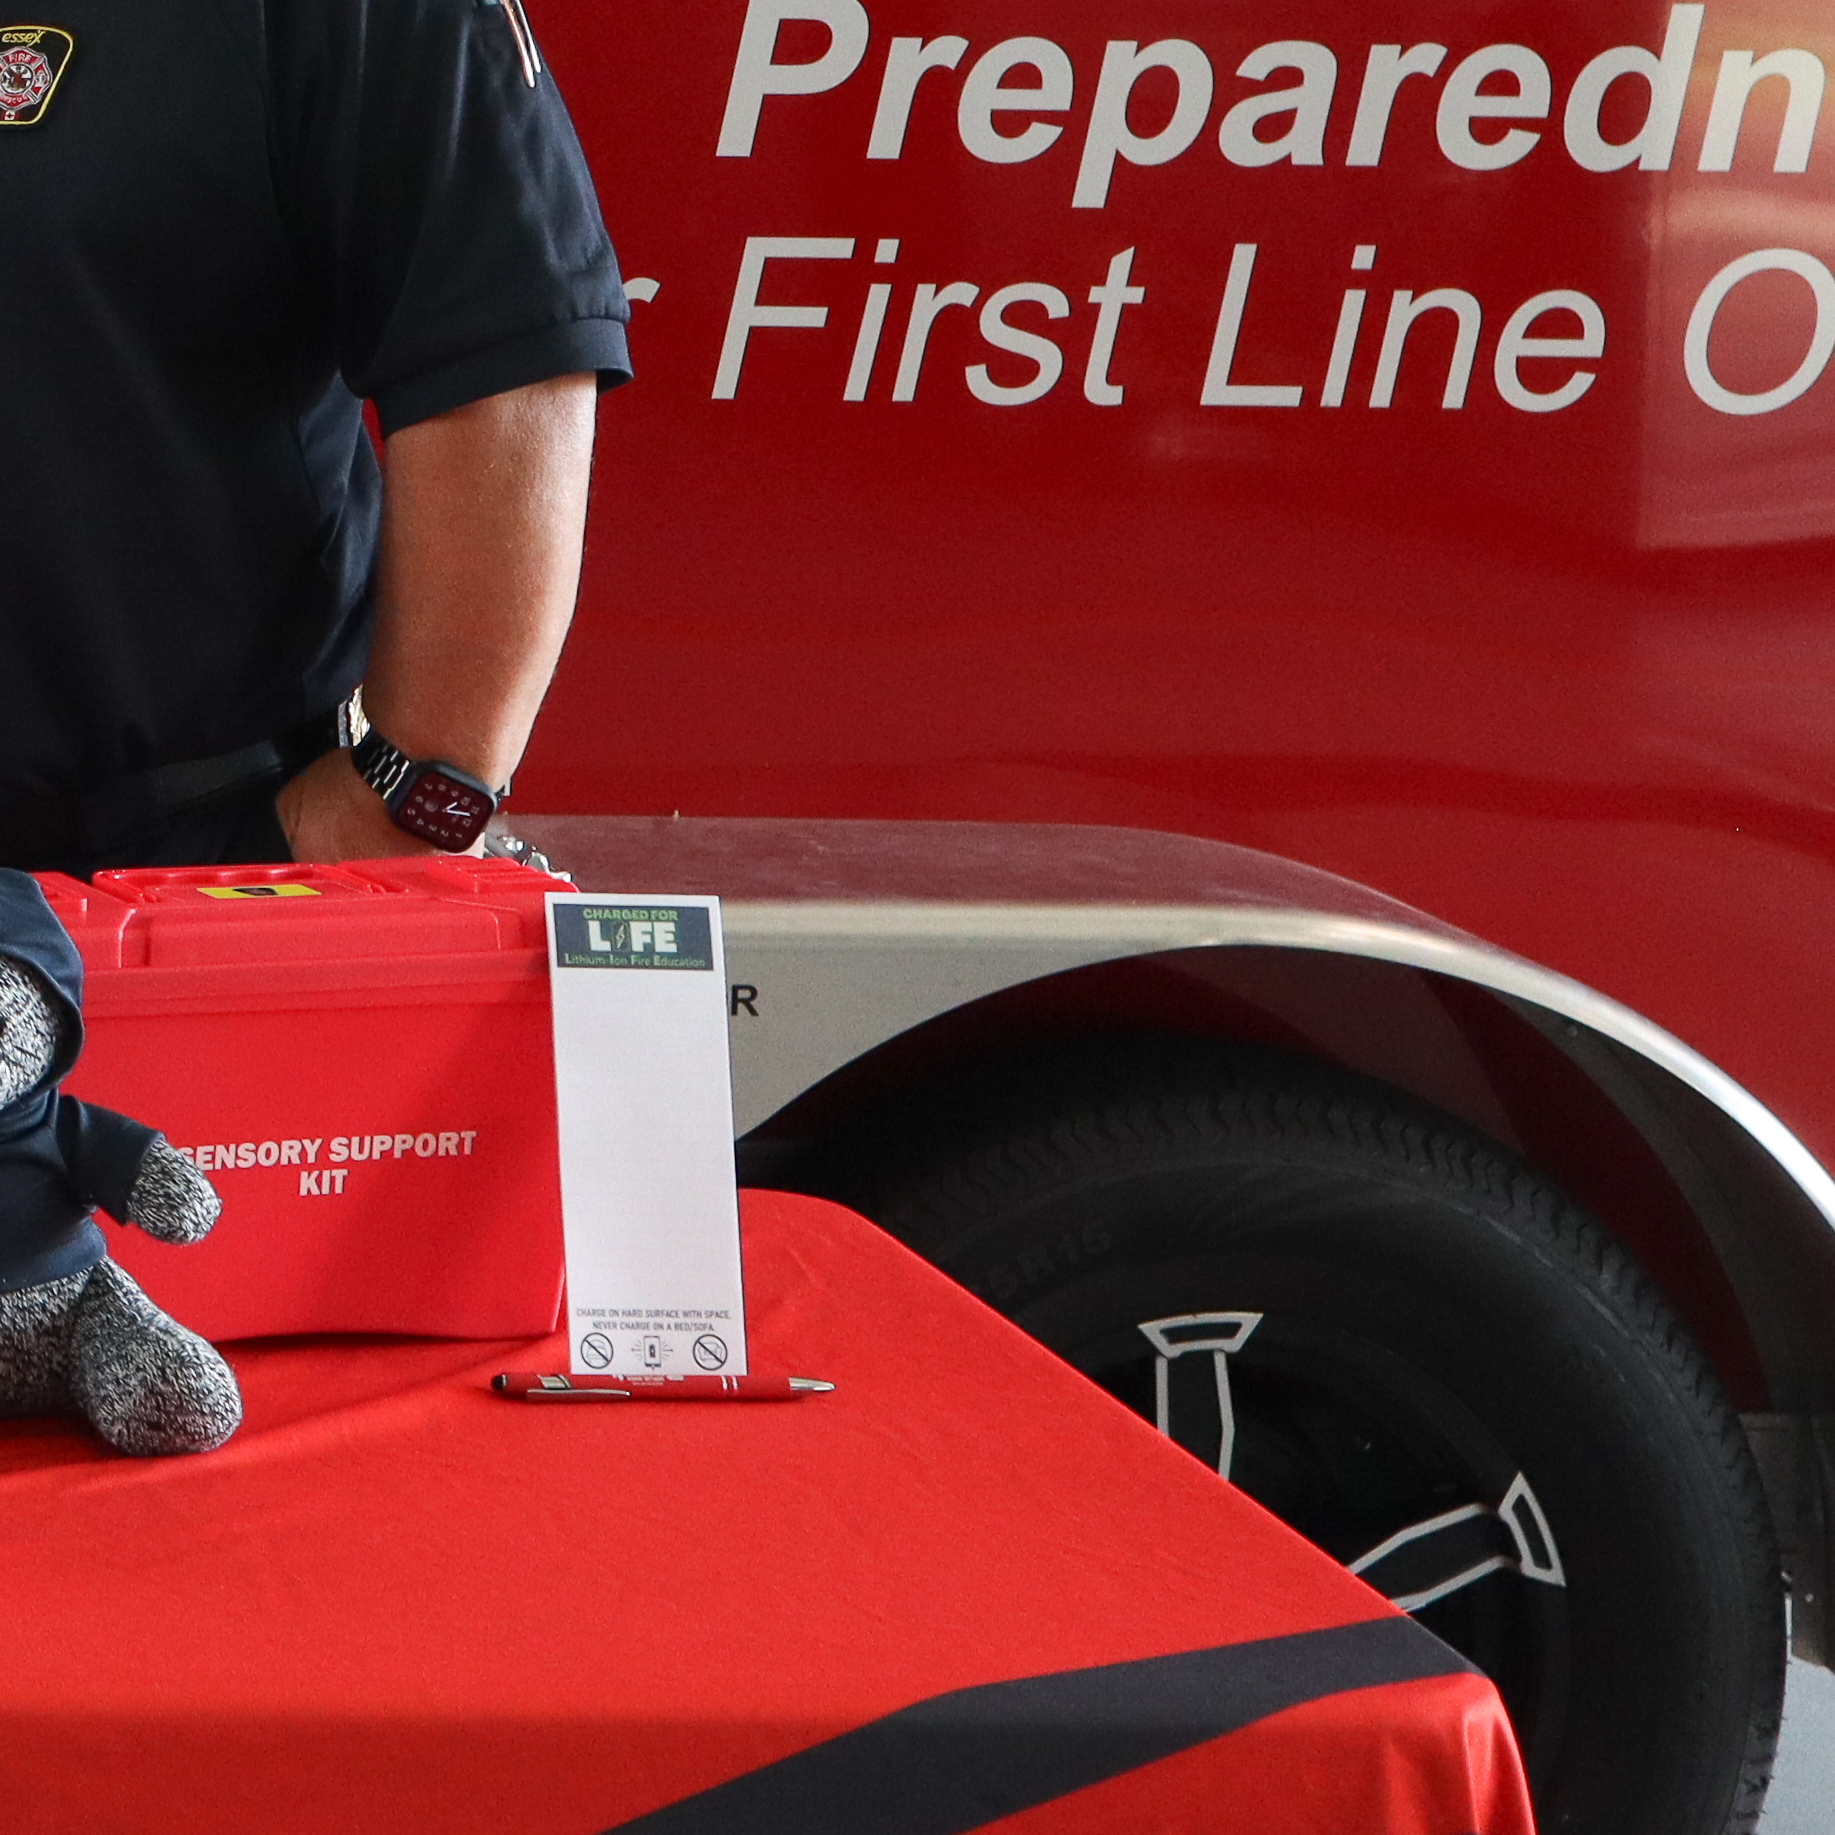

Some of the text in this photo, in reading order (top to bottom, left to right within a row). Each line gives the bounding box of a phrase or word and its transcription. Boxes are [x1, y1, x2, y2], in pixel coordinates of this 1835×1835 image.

[2, 29, 46, 47] essex
[9, 53, 31, 63] FIRE
[709, 235, 1145, 406] First
[1199, 242, 1607, 414] Line
[583, 908, 678, 921] CHARGED FOR
[631, 955, 651, 966] Fire
[654, 955, 705, 967] Education
[328, 1131, 477, 1163] SUPPORT
[298, 1169, 349, 1196] KIT
[577, 1308, 605, 1317] CHARGE
[609, 1309, 619, 1317] ON
[646, 1310, 679, 1318] SURFACE
[683, 1311, 702, 1319] WITH
[593, 1322, 617, 1330] NEVER
[620, 1322, 650, 1330] CHARGE
[667, 1323, 672, 1331] A
